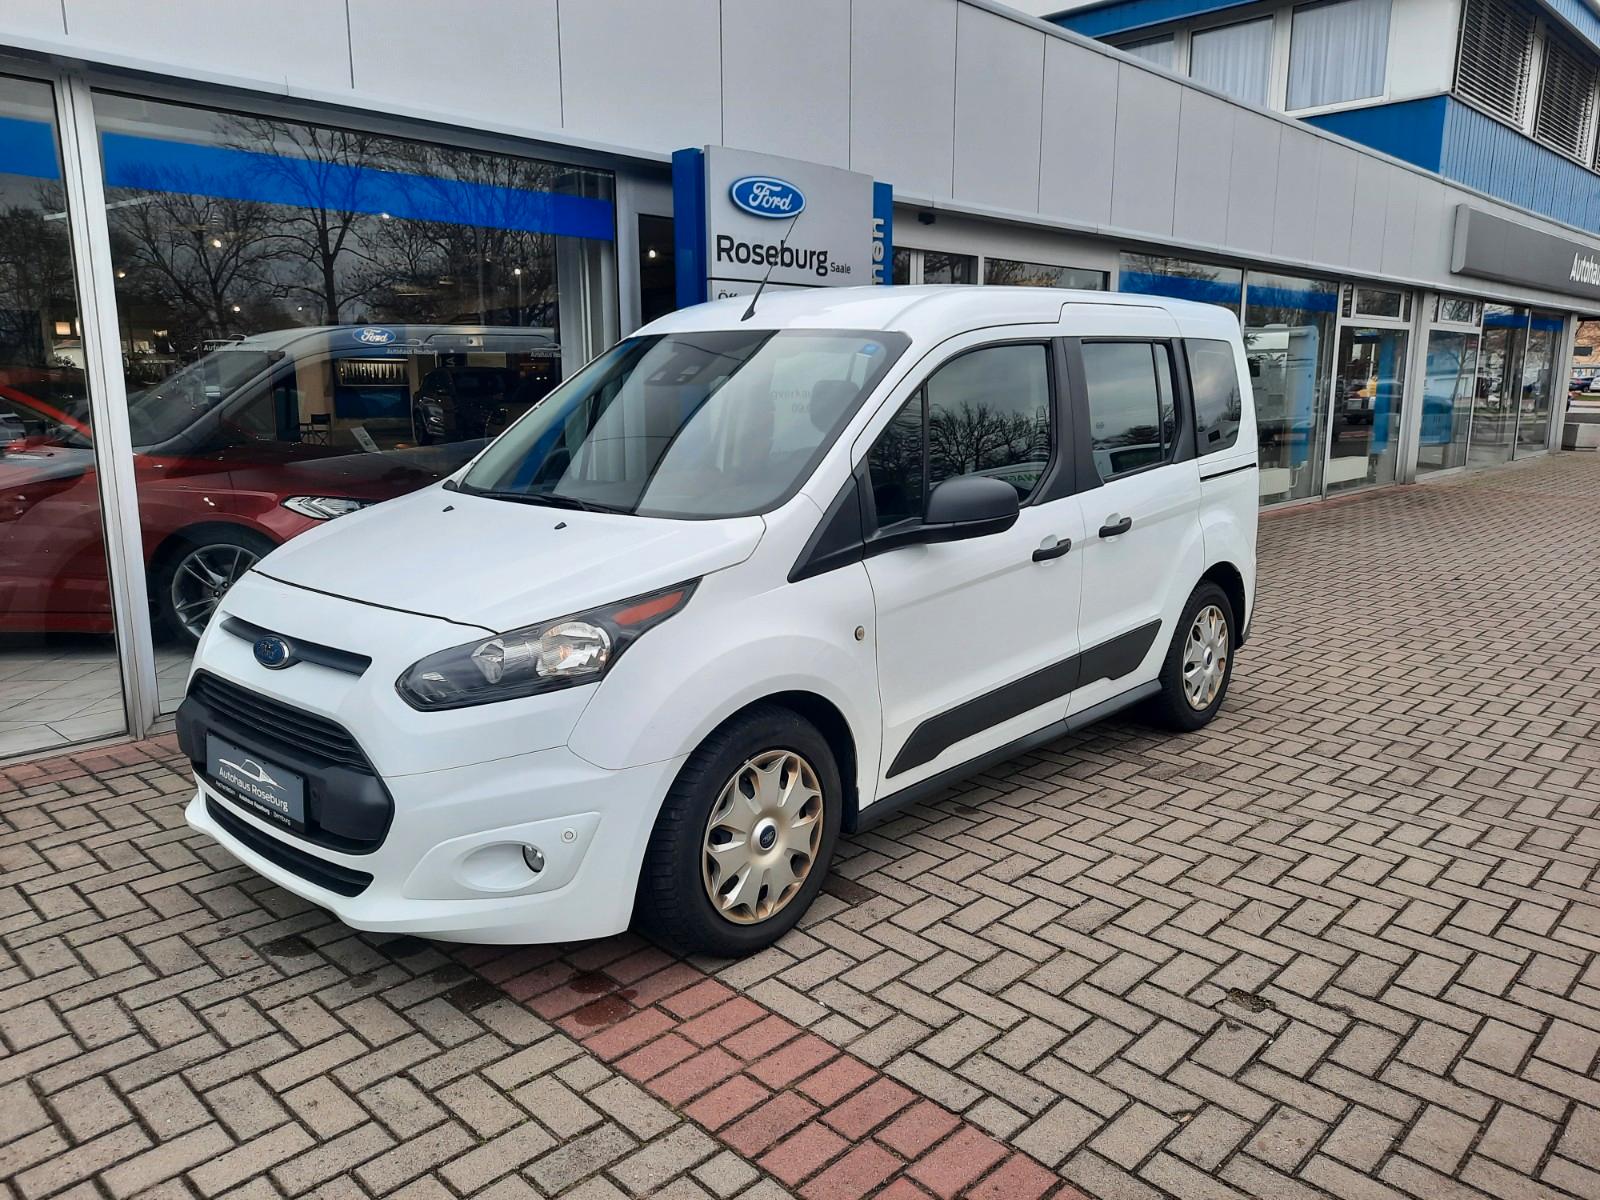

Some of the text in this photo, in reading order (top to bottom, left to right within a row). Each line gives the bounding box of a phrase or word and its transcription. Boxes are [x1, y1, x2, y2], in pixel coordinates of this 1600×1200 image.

[749, 183, 792, 210] Ford
[716, 234, 851, 277] Roseburg Saale
[1569, 252, 1600, 286] Autohau
[219, 767, 250, 791] Autohaus
[251, 784, 288, 812] Roseburg
